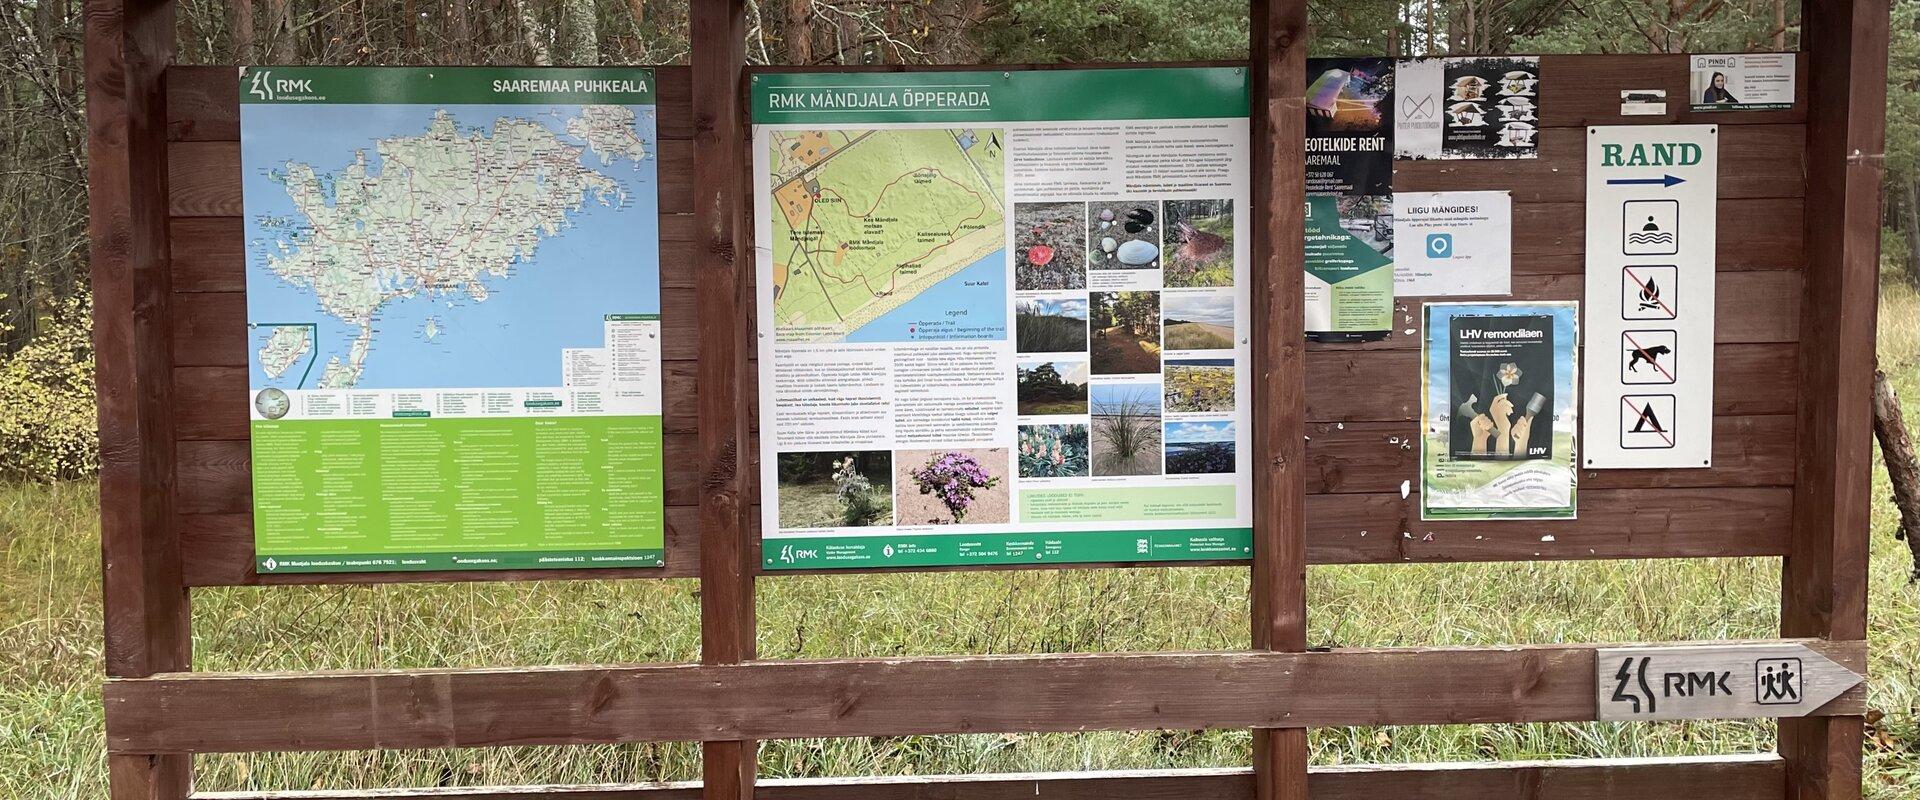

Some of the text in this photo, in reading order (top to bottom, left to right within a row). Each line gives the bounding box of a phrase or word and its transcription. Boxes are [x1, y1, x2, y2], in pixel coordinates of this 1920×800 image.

[277, 79, 312, 93] RMK
[493, 79, 648, 93] SAAREMAA PUHKEALA
[769, 88, 990, 108] RMK MÄNDJALA ÕPPERADA
[1359, 137, 1386, 152] RENT
[1305, 154, 1341, 167] AREMAAL
[1601, 143, 1703, 167] RAND
[1431, 205, 1479, 214] MÄNGIDES!
[945, 309, 968, 317] Legend
[1460, 328, 1543, 339] LHV remondilaen
[1529, 447, 1547, 455] LHV
[796, 549, 818, 559] RMK
[1664, 671, 1733, 698] RMK
